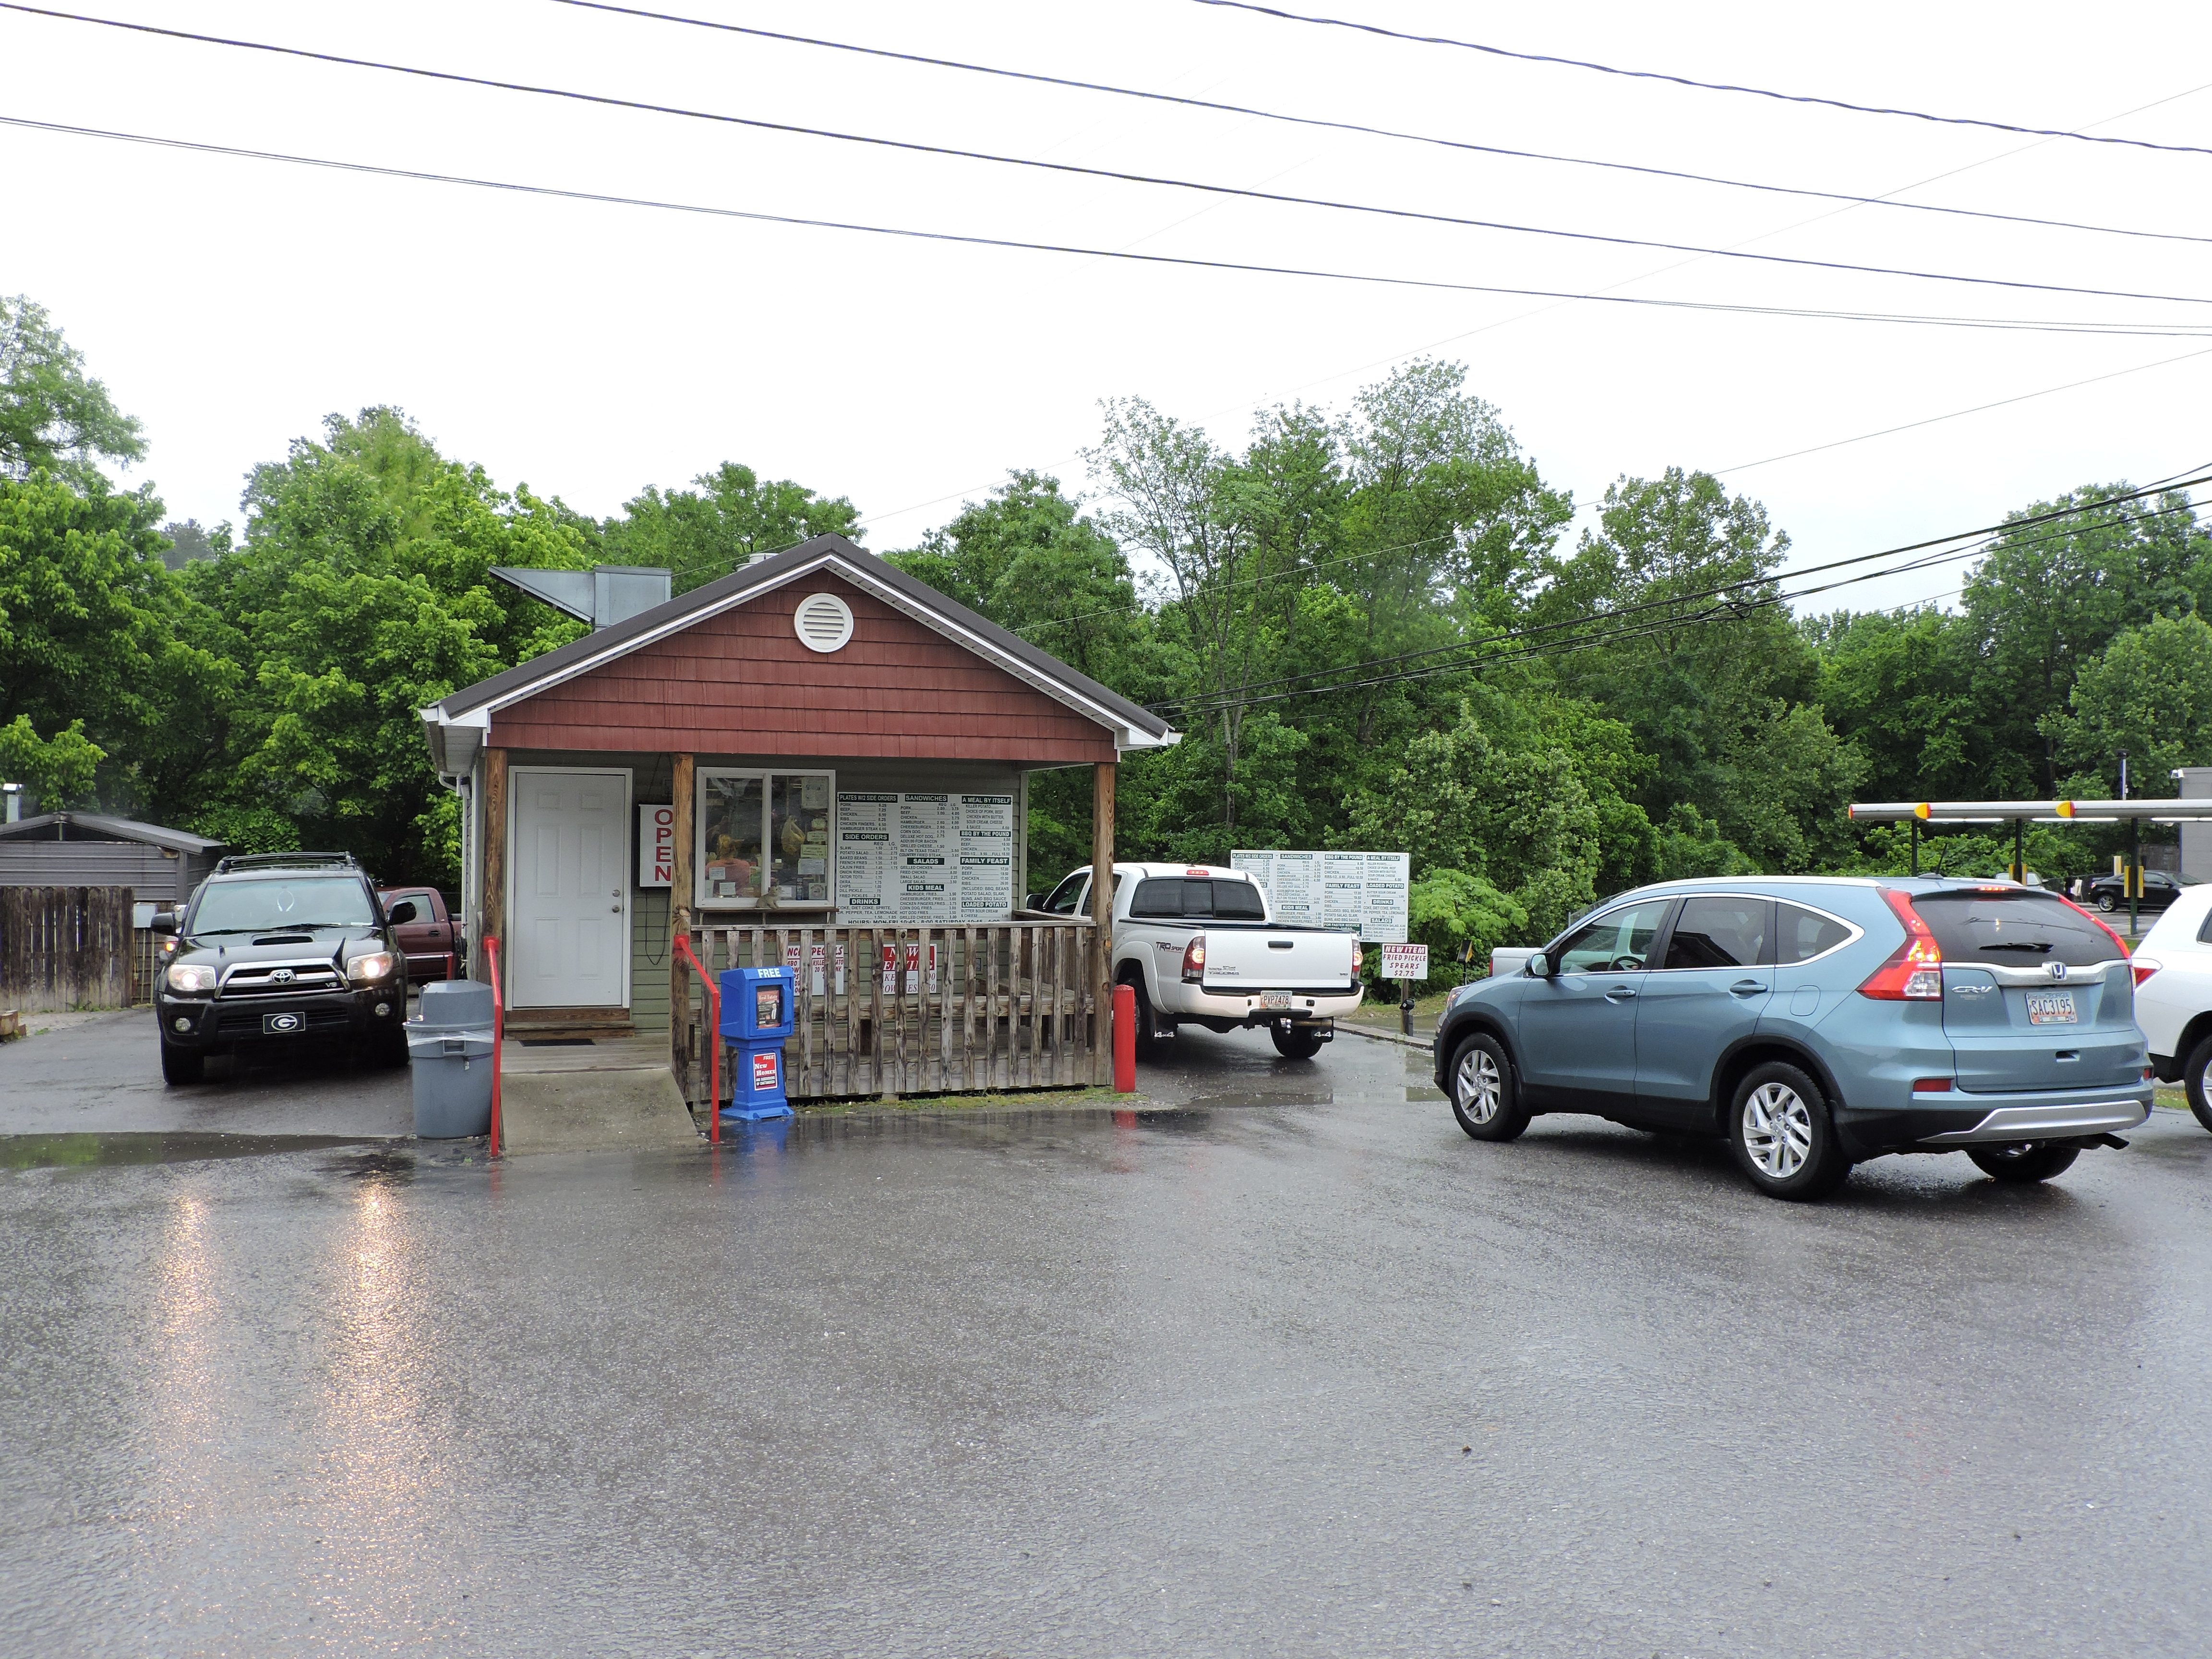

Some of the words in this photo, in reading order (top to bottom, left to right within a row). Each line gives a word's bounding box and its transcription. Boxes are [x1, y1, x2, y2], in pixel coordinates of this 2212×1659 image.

[654, 809, 673, 881] OPEN
[1155, 941, 1171, 952] TRD
[757, 968, 782, 978] FREE
[1263, 995, 1289, 1004] PVP7478
[2031, 999, 2072, 1015] SAC3195
